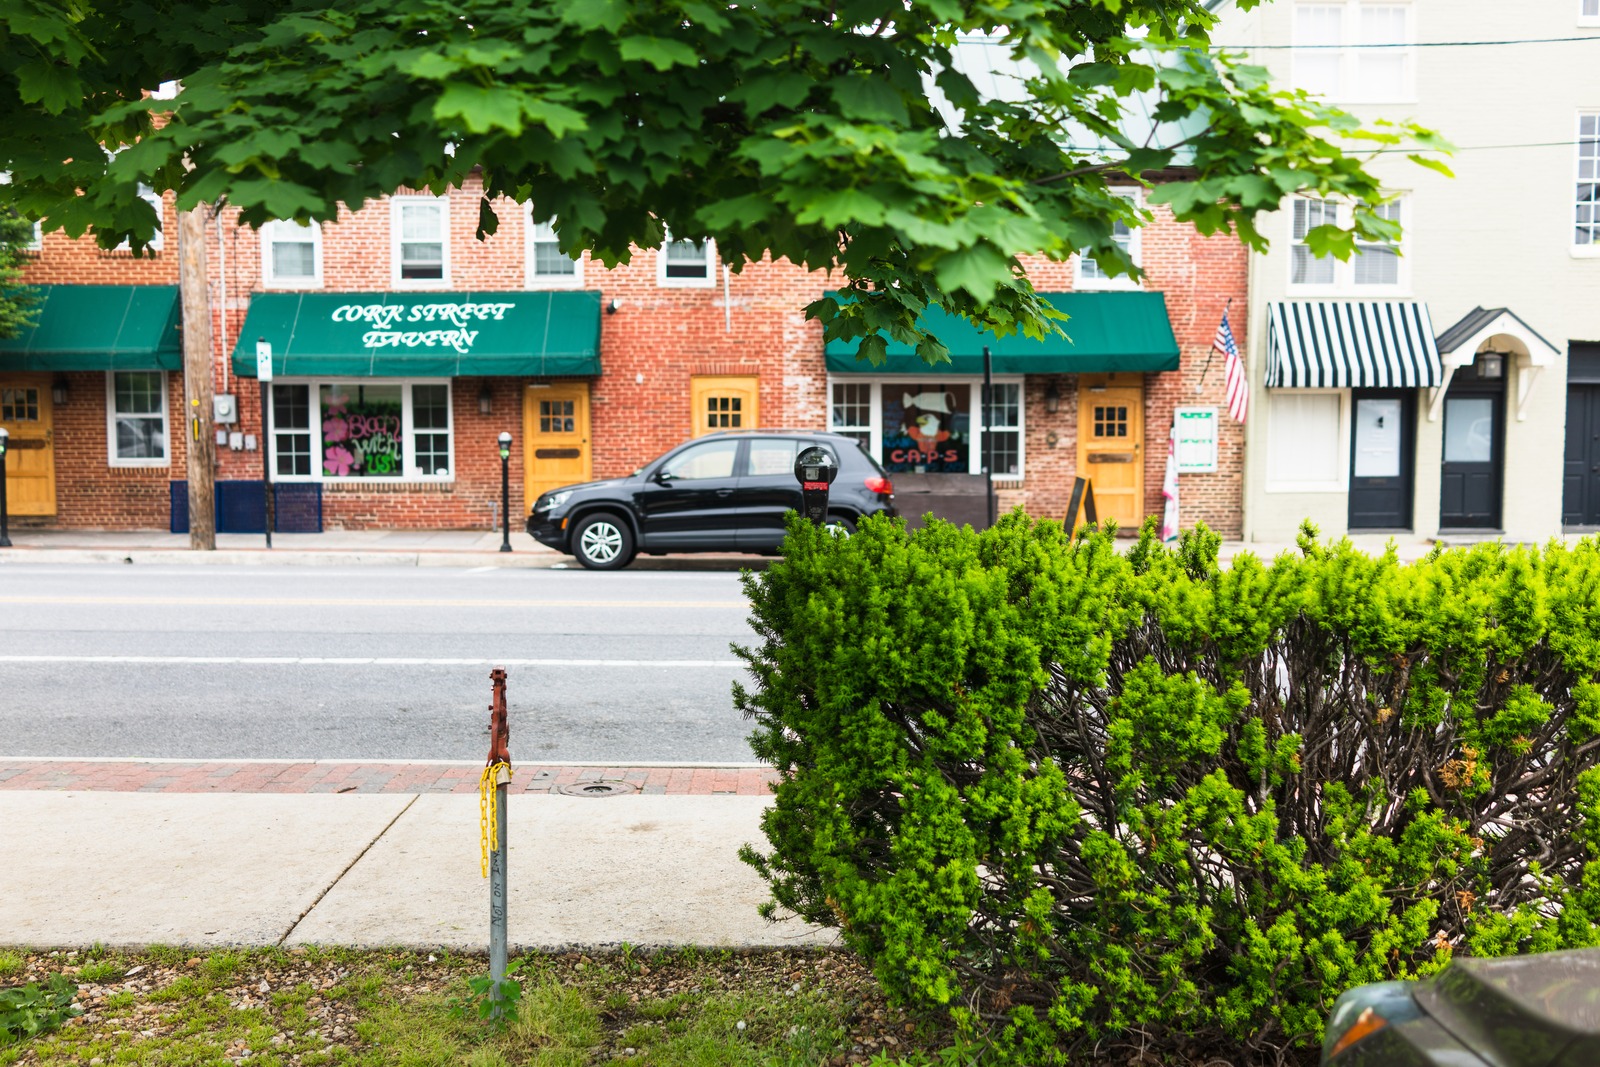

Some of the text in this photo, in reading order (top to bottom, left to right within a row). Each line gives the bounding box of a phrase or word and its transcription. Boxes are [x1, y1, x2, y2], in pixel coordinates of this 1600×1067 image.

[331, 303, 516, 329] CORK STREET
[362, 328, 479, 354] TAVERN
